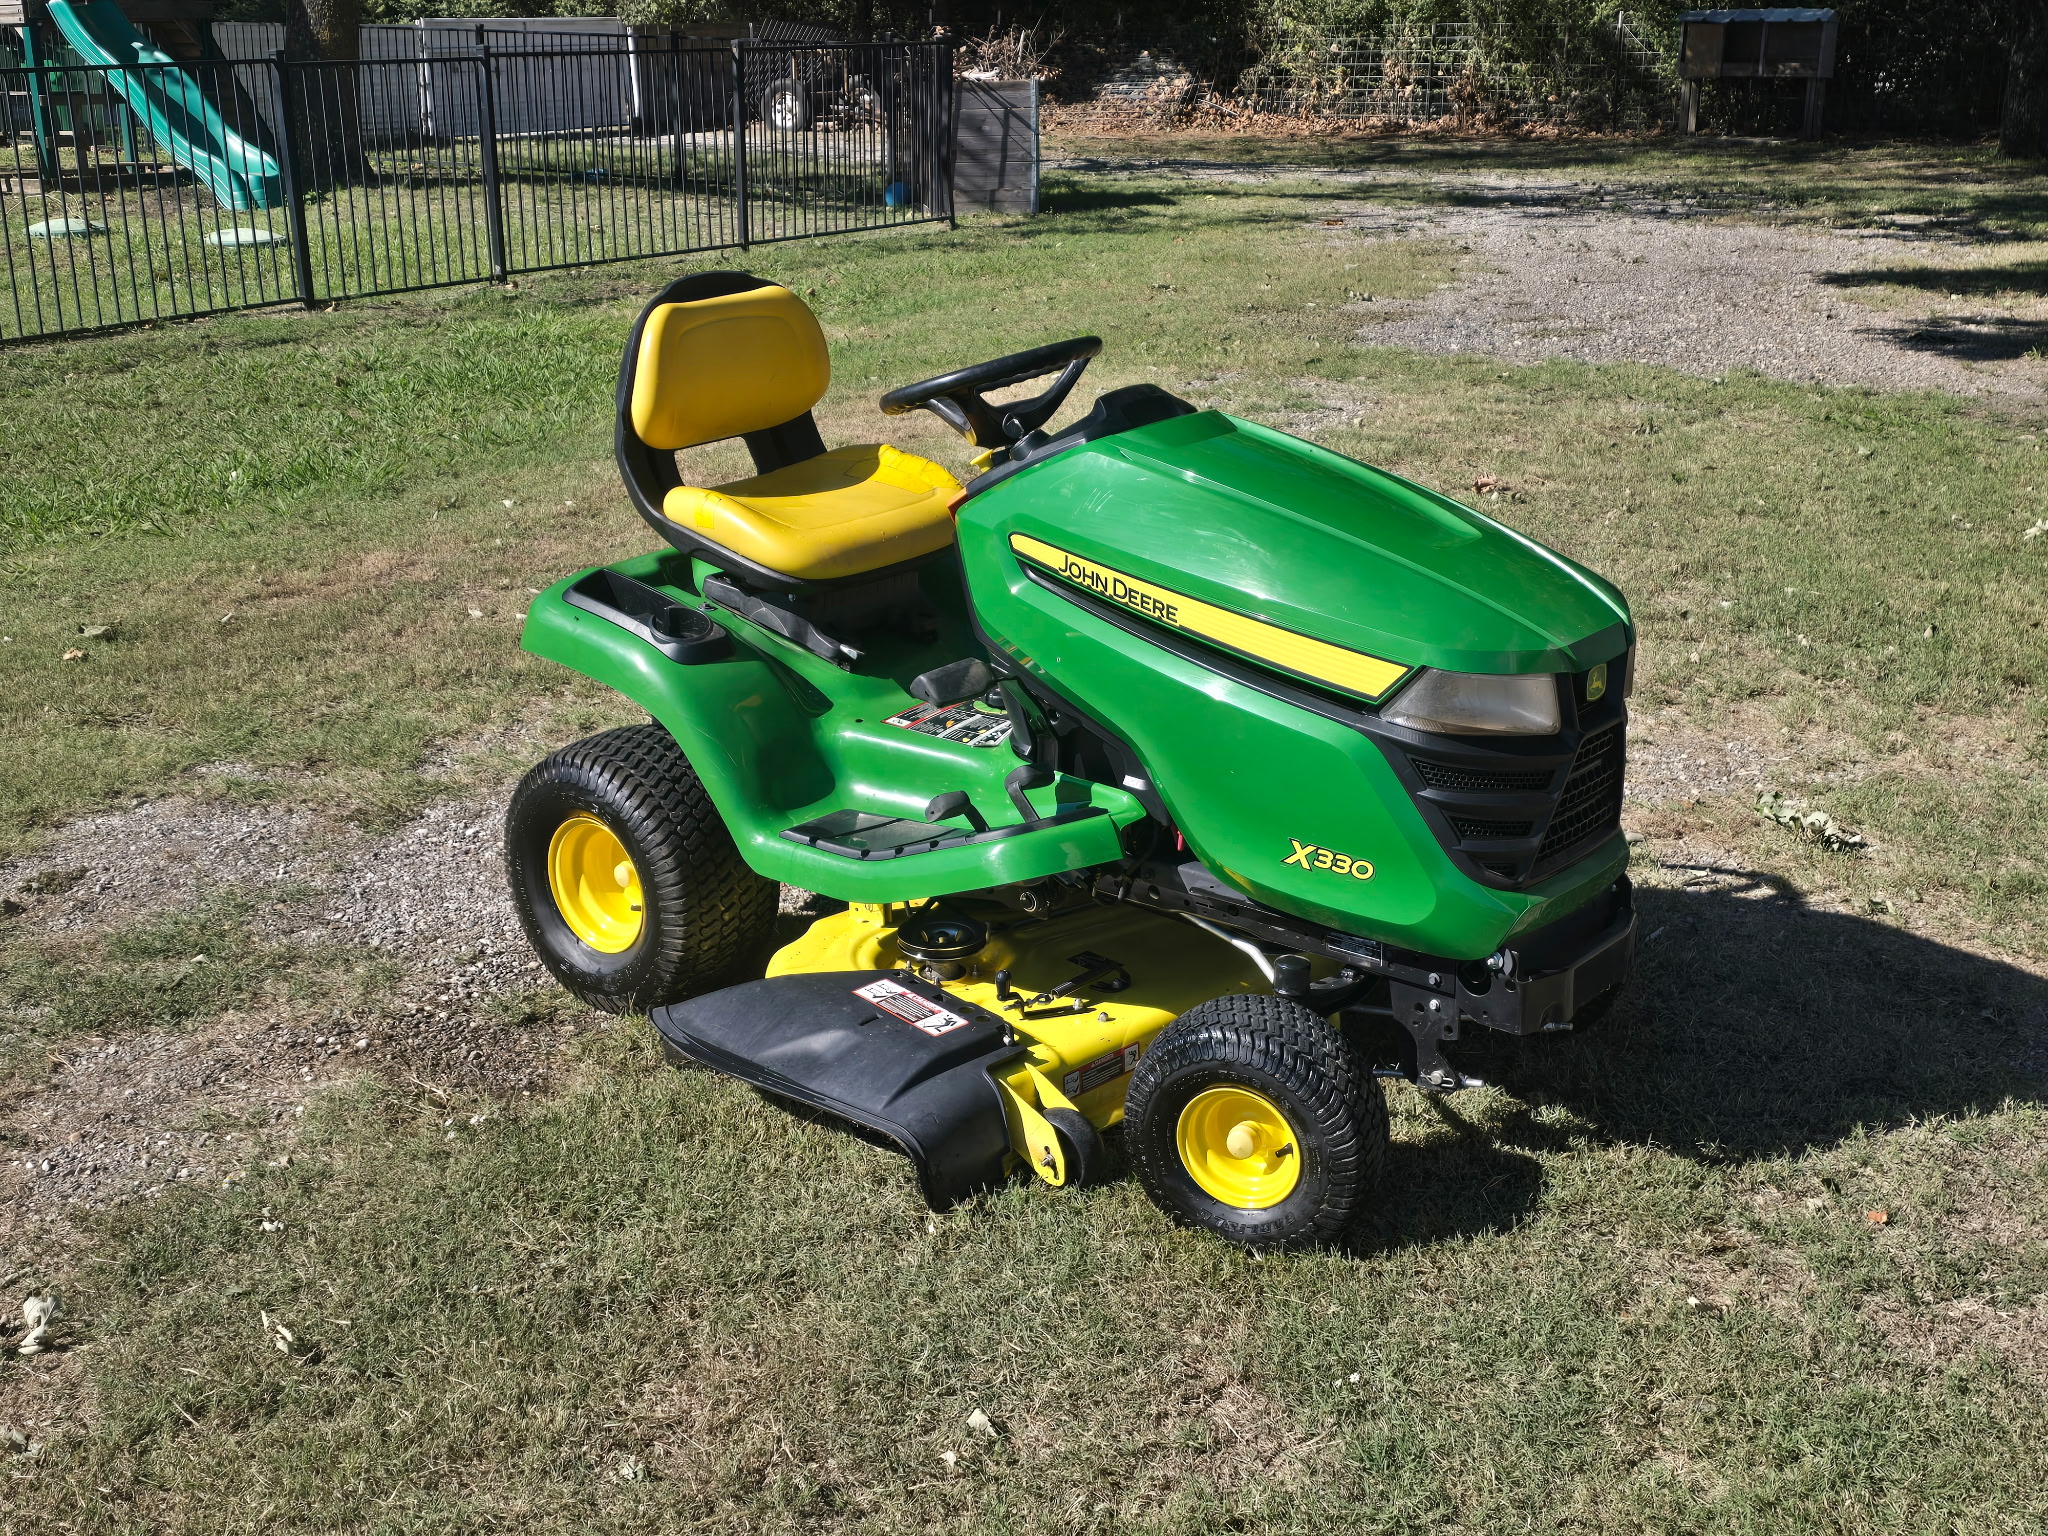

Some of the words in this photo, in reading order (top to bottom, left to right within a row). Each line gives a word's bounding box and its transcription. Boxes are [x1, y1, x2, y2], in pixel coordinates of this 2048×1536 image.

[1058, 555, 1108, 593] JOHN
[1112, 577, 1178, 623] DEERE
[1280, 838, 1375, 880] X330
